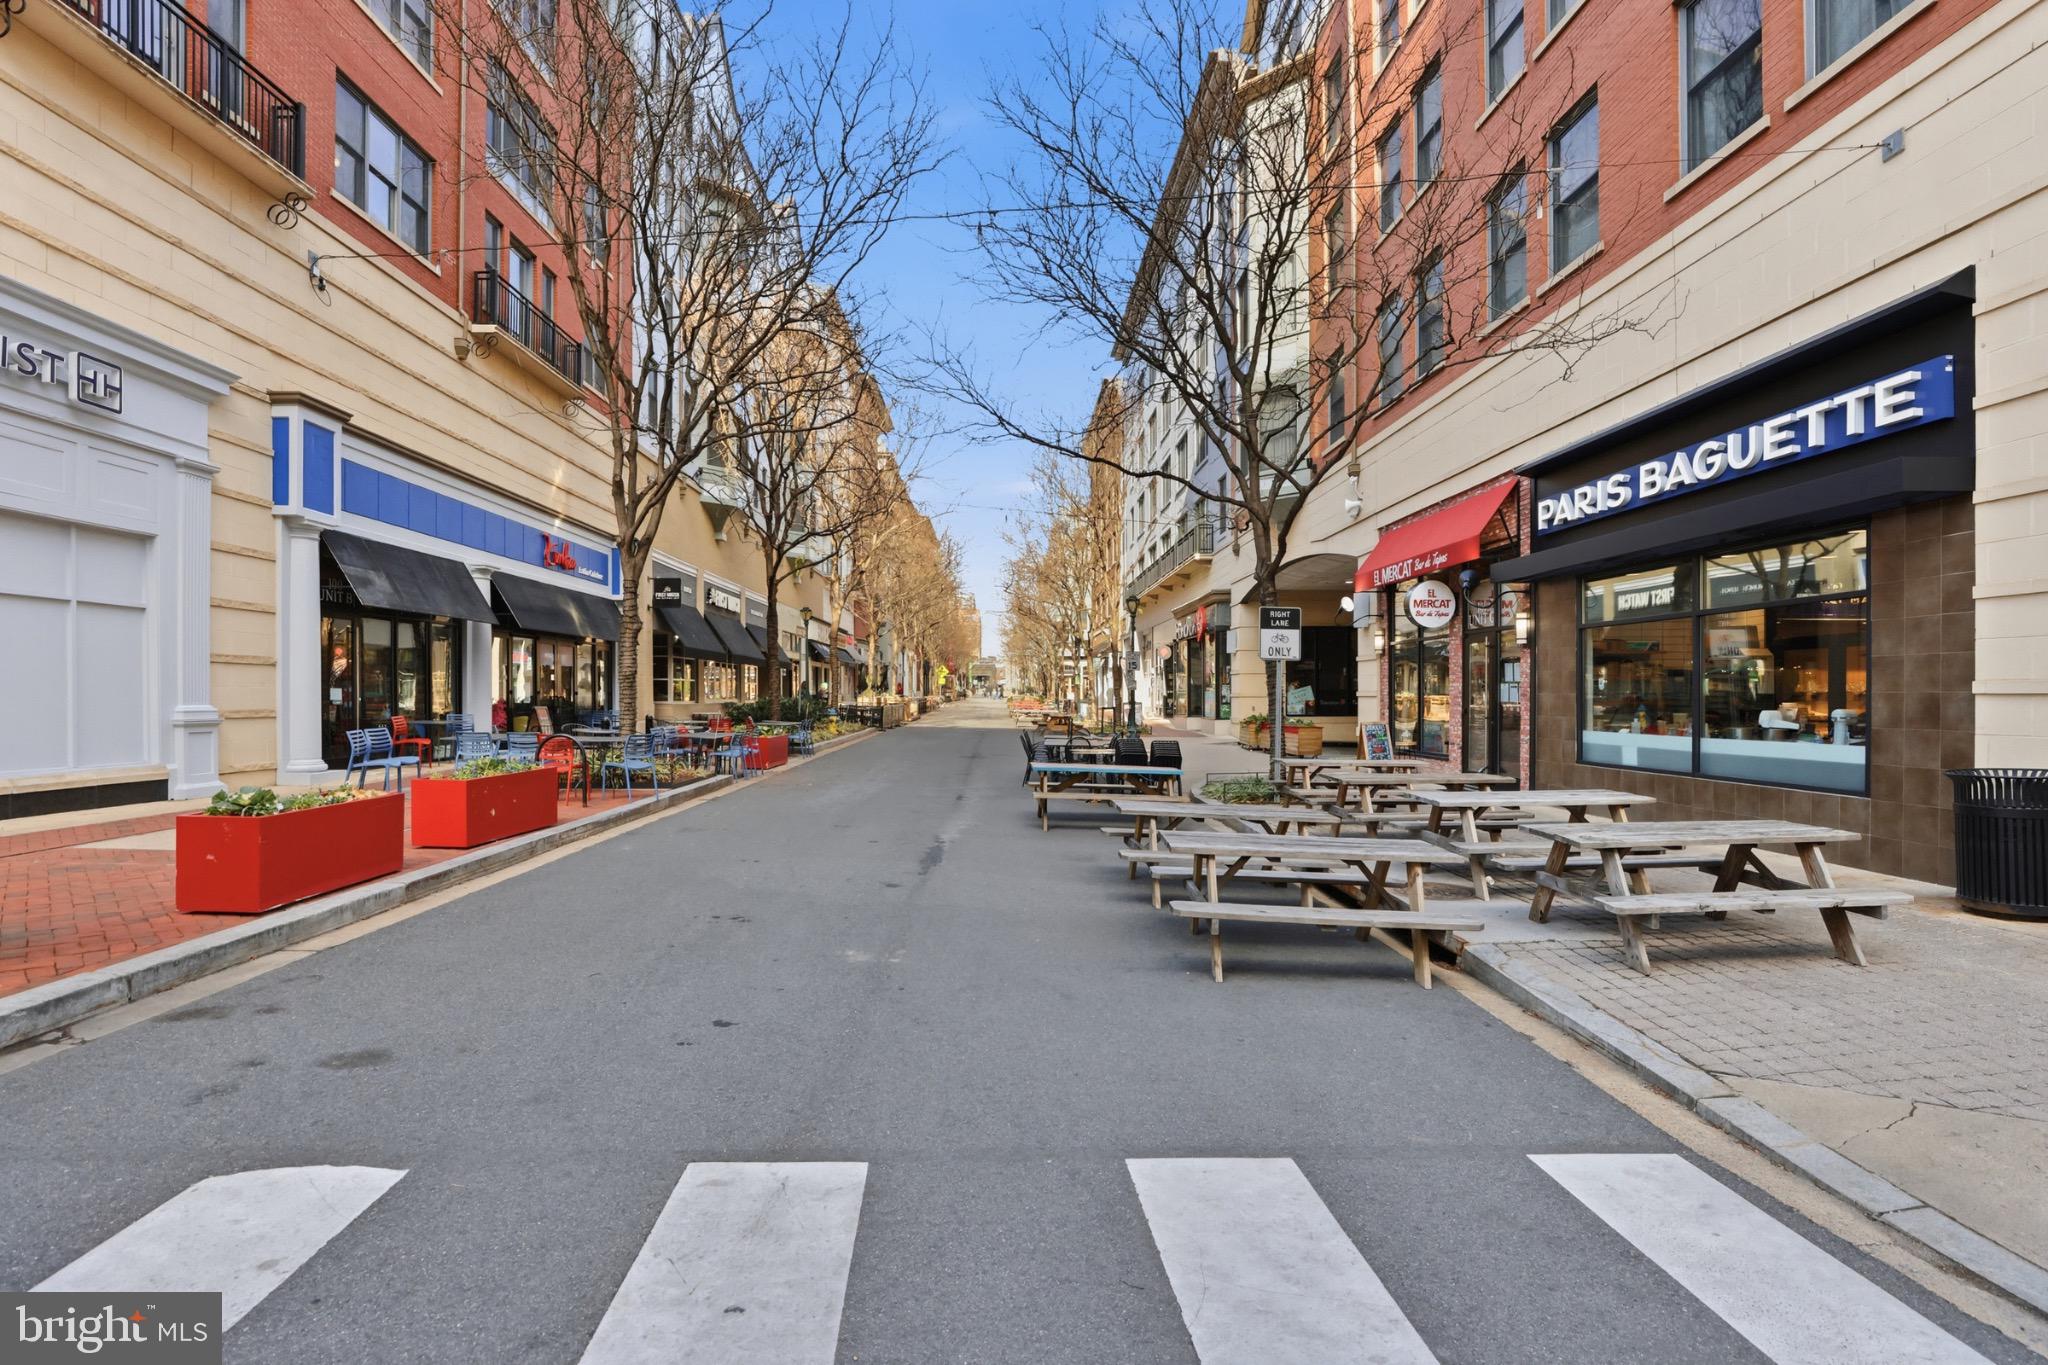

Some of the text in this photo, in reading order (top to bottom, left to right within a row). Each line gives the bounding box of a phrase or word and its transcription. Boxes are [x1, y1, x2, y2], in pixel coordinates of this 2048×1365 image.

[1537, 370, 1924, 530] PARIS BAGUETTE
[1373, 570, 1382, 587] EL
[1382, 559, 1413, 584] MERCAT
[1414, 558, 1424, 571] Bar
[1432, 551, 1448, 568] Tapas
[1427, 589, 1437, 598] EL
[1413, 600, 1451, 608] MERCAT
[1270, 610, 1291, 618] RIGHT
[1271, 619, 1290, 627] LANE
[1267, 646, 1292, 657] ONLY
[1128, 661, 1138, 670] 15
